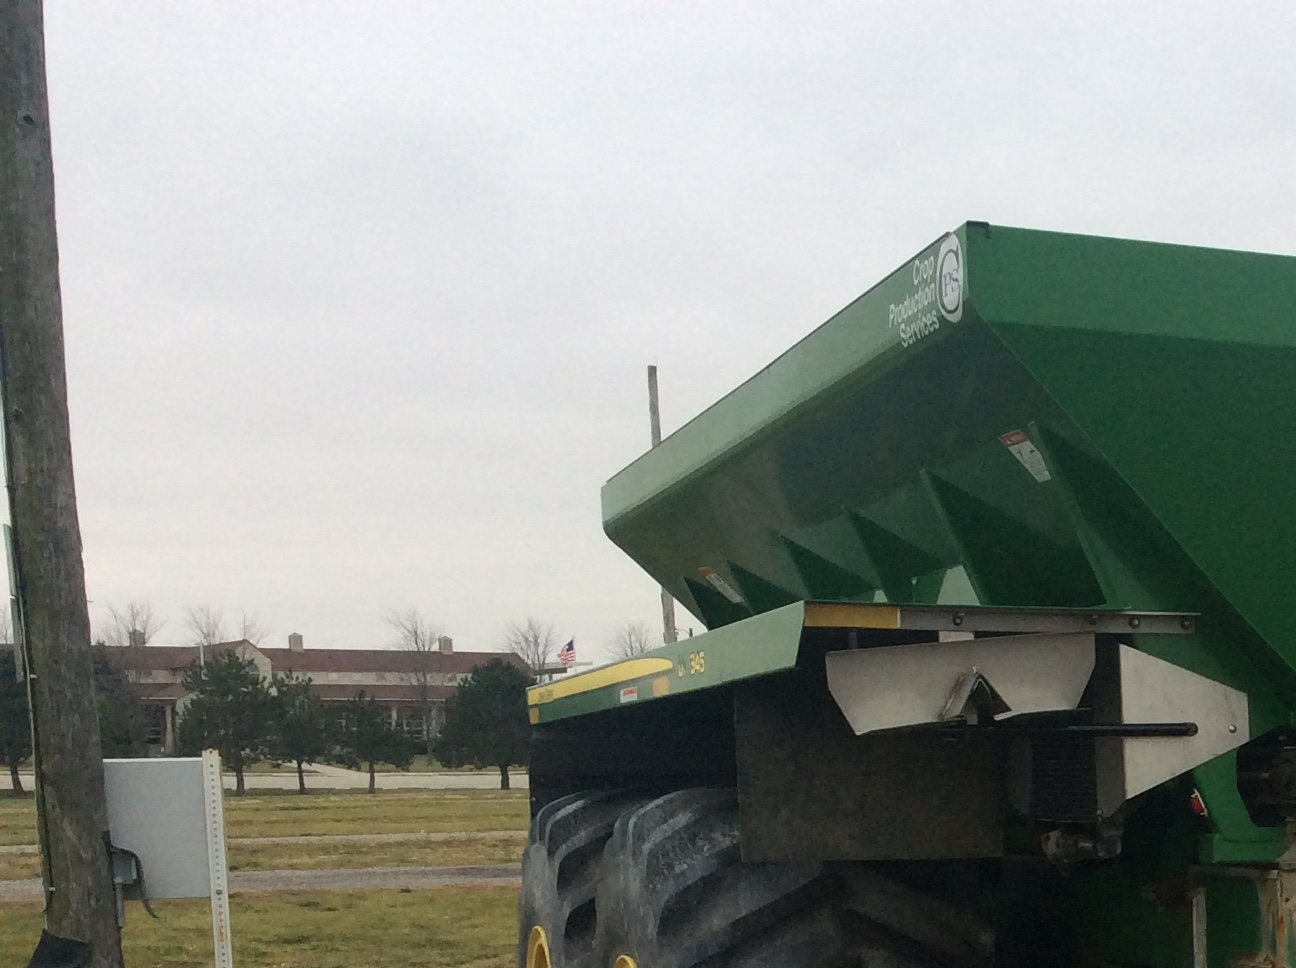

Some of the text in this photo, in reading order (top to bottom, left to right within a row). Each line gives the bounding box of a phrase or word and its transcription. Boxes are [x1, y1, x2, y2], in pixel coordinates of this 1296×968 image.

[912, 255, 935, 286] Crop
[888, 282, 936, 328] Production
[899, 309, 940, 347] Services
